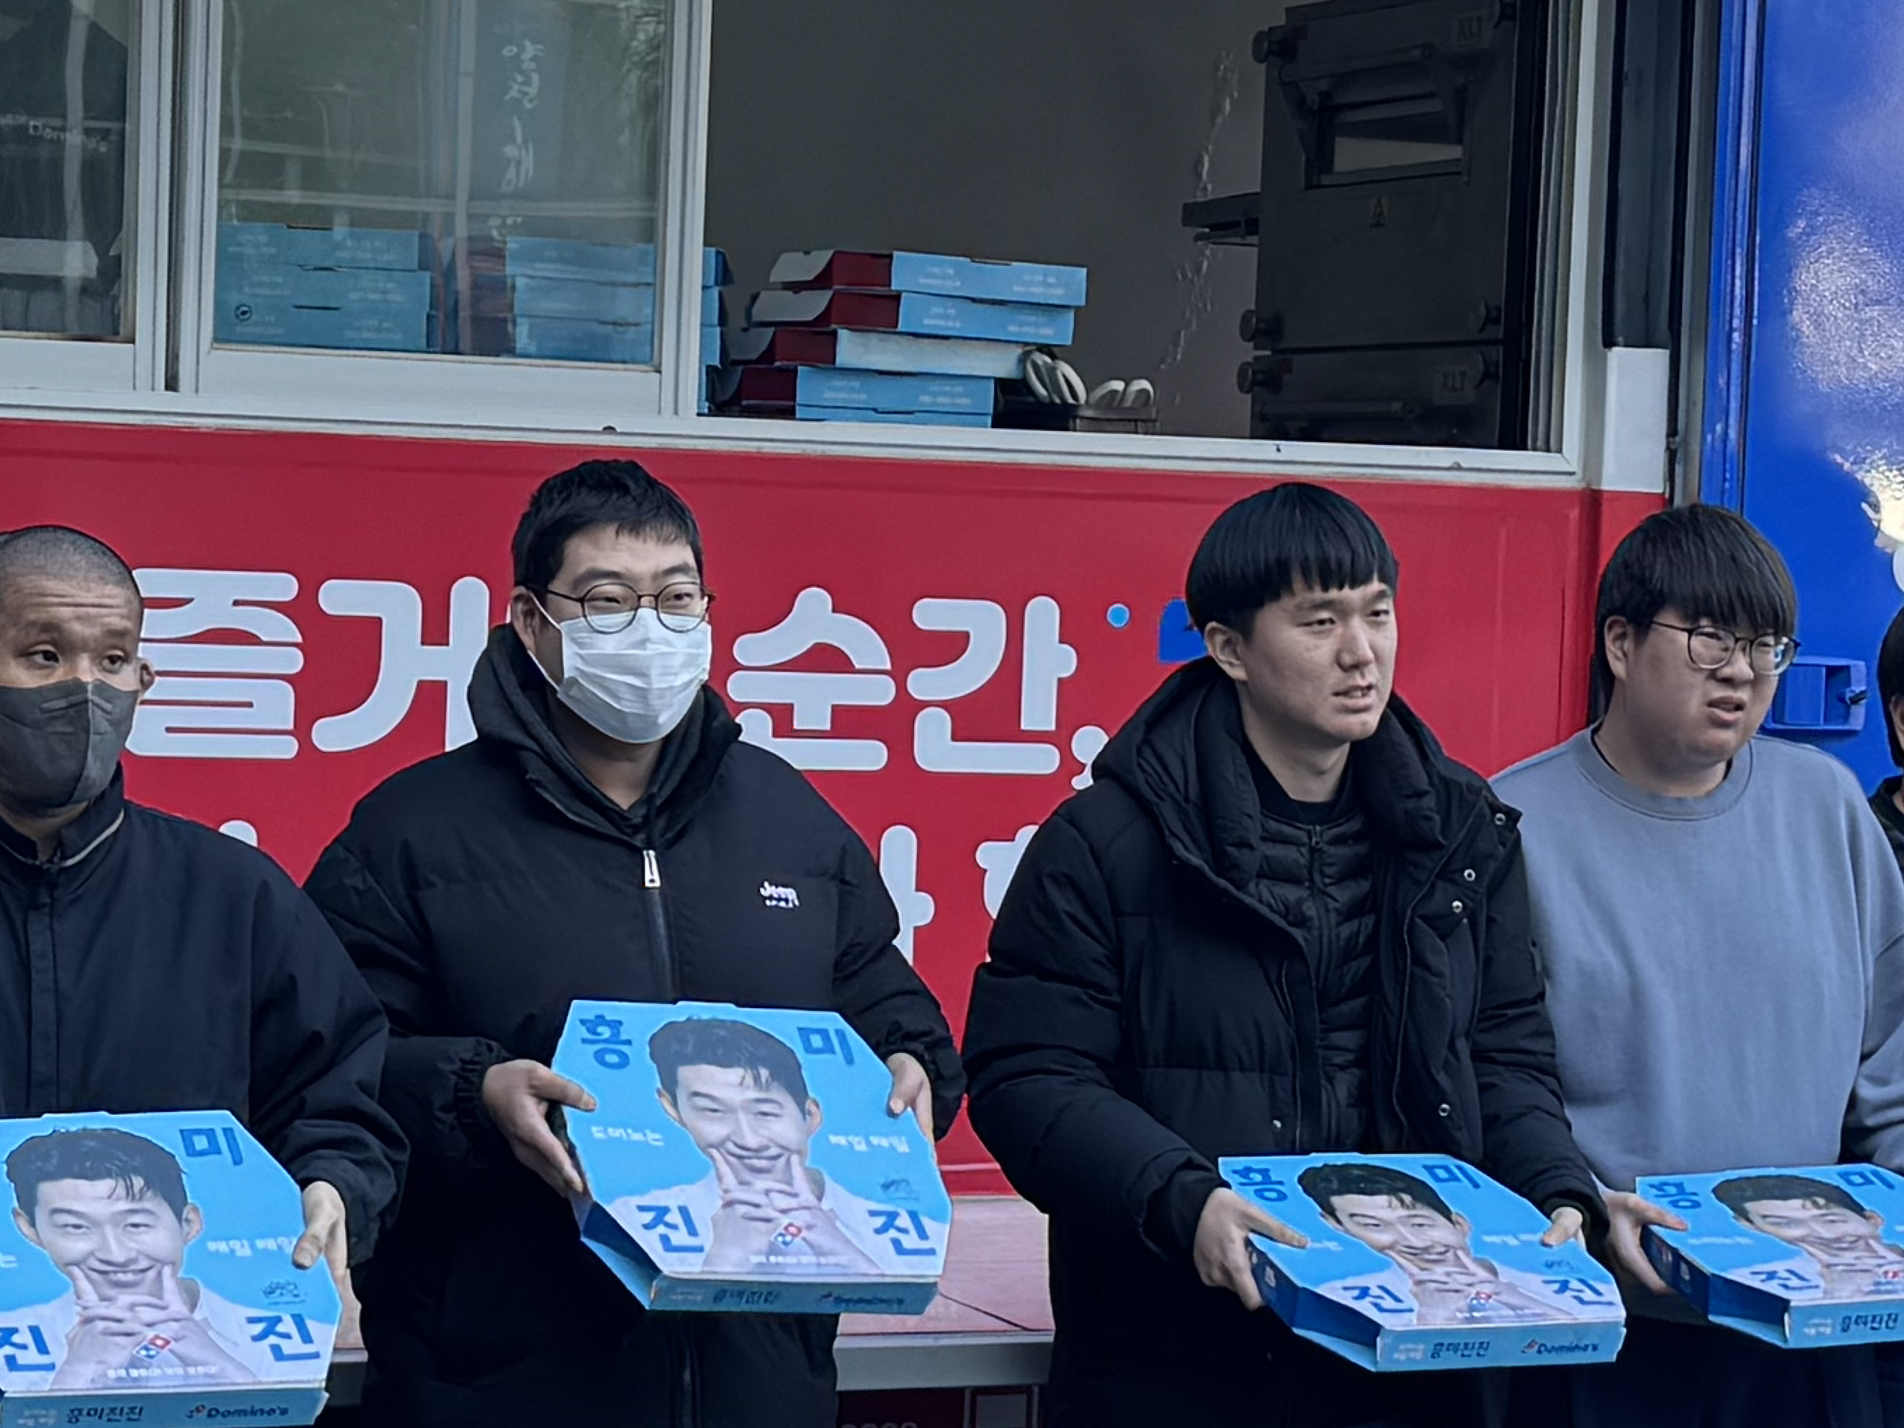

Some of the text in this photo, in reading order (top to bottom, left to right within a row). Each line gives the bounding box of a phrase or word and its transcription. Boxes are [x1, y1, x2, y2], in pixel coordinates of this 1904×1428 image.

[125, 568, 490, 759] 즐거
[796, 1026, 855, 1066] 미
[178, 1126, 242, 1167] 미
[1422, 1163, 1480, 1190] 미
[1837, 1169, 1897, 1192] 미
[635, 1204, 938, 1257] 진 진
[1342, 1276, 1615, 1315] 진 진
[1749, 1267, 1821, 1293] 진
[245, 1313, 321, 1363] 진
[206, 1403, 290, 1420] Domino's
